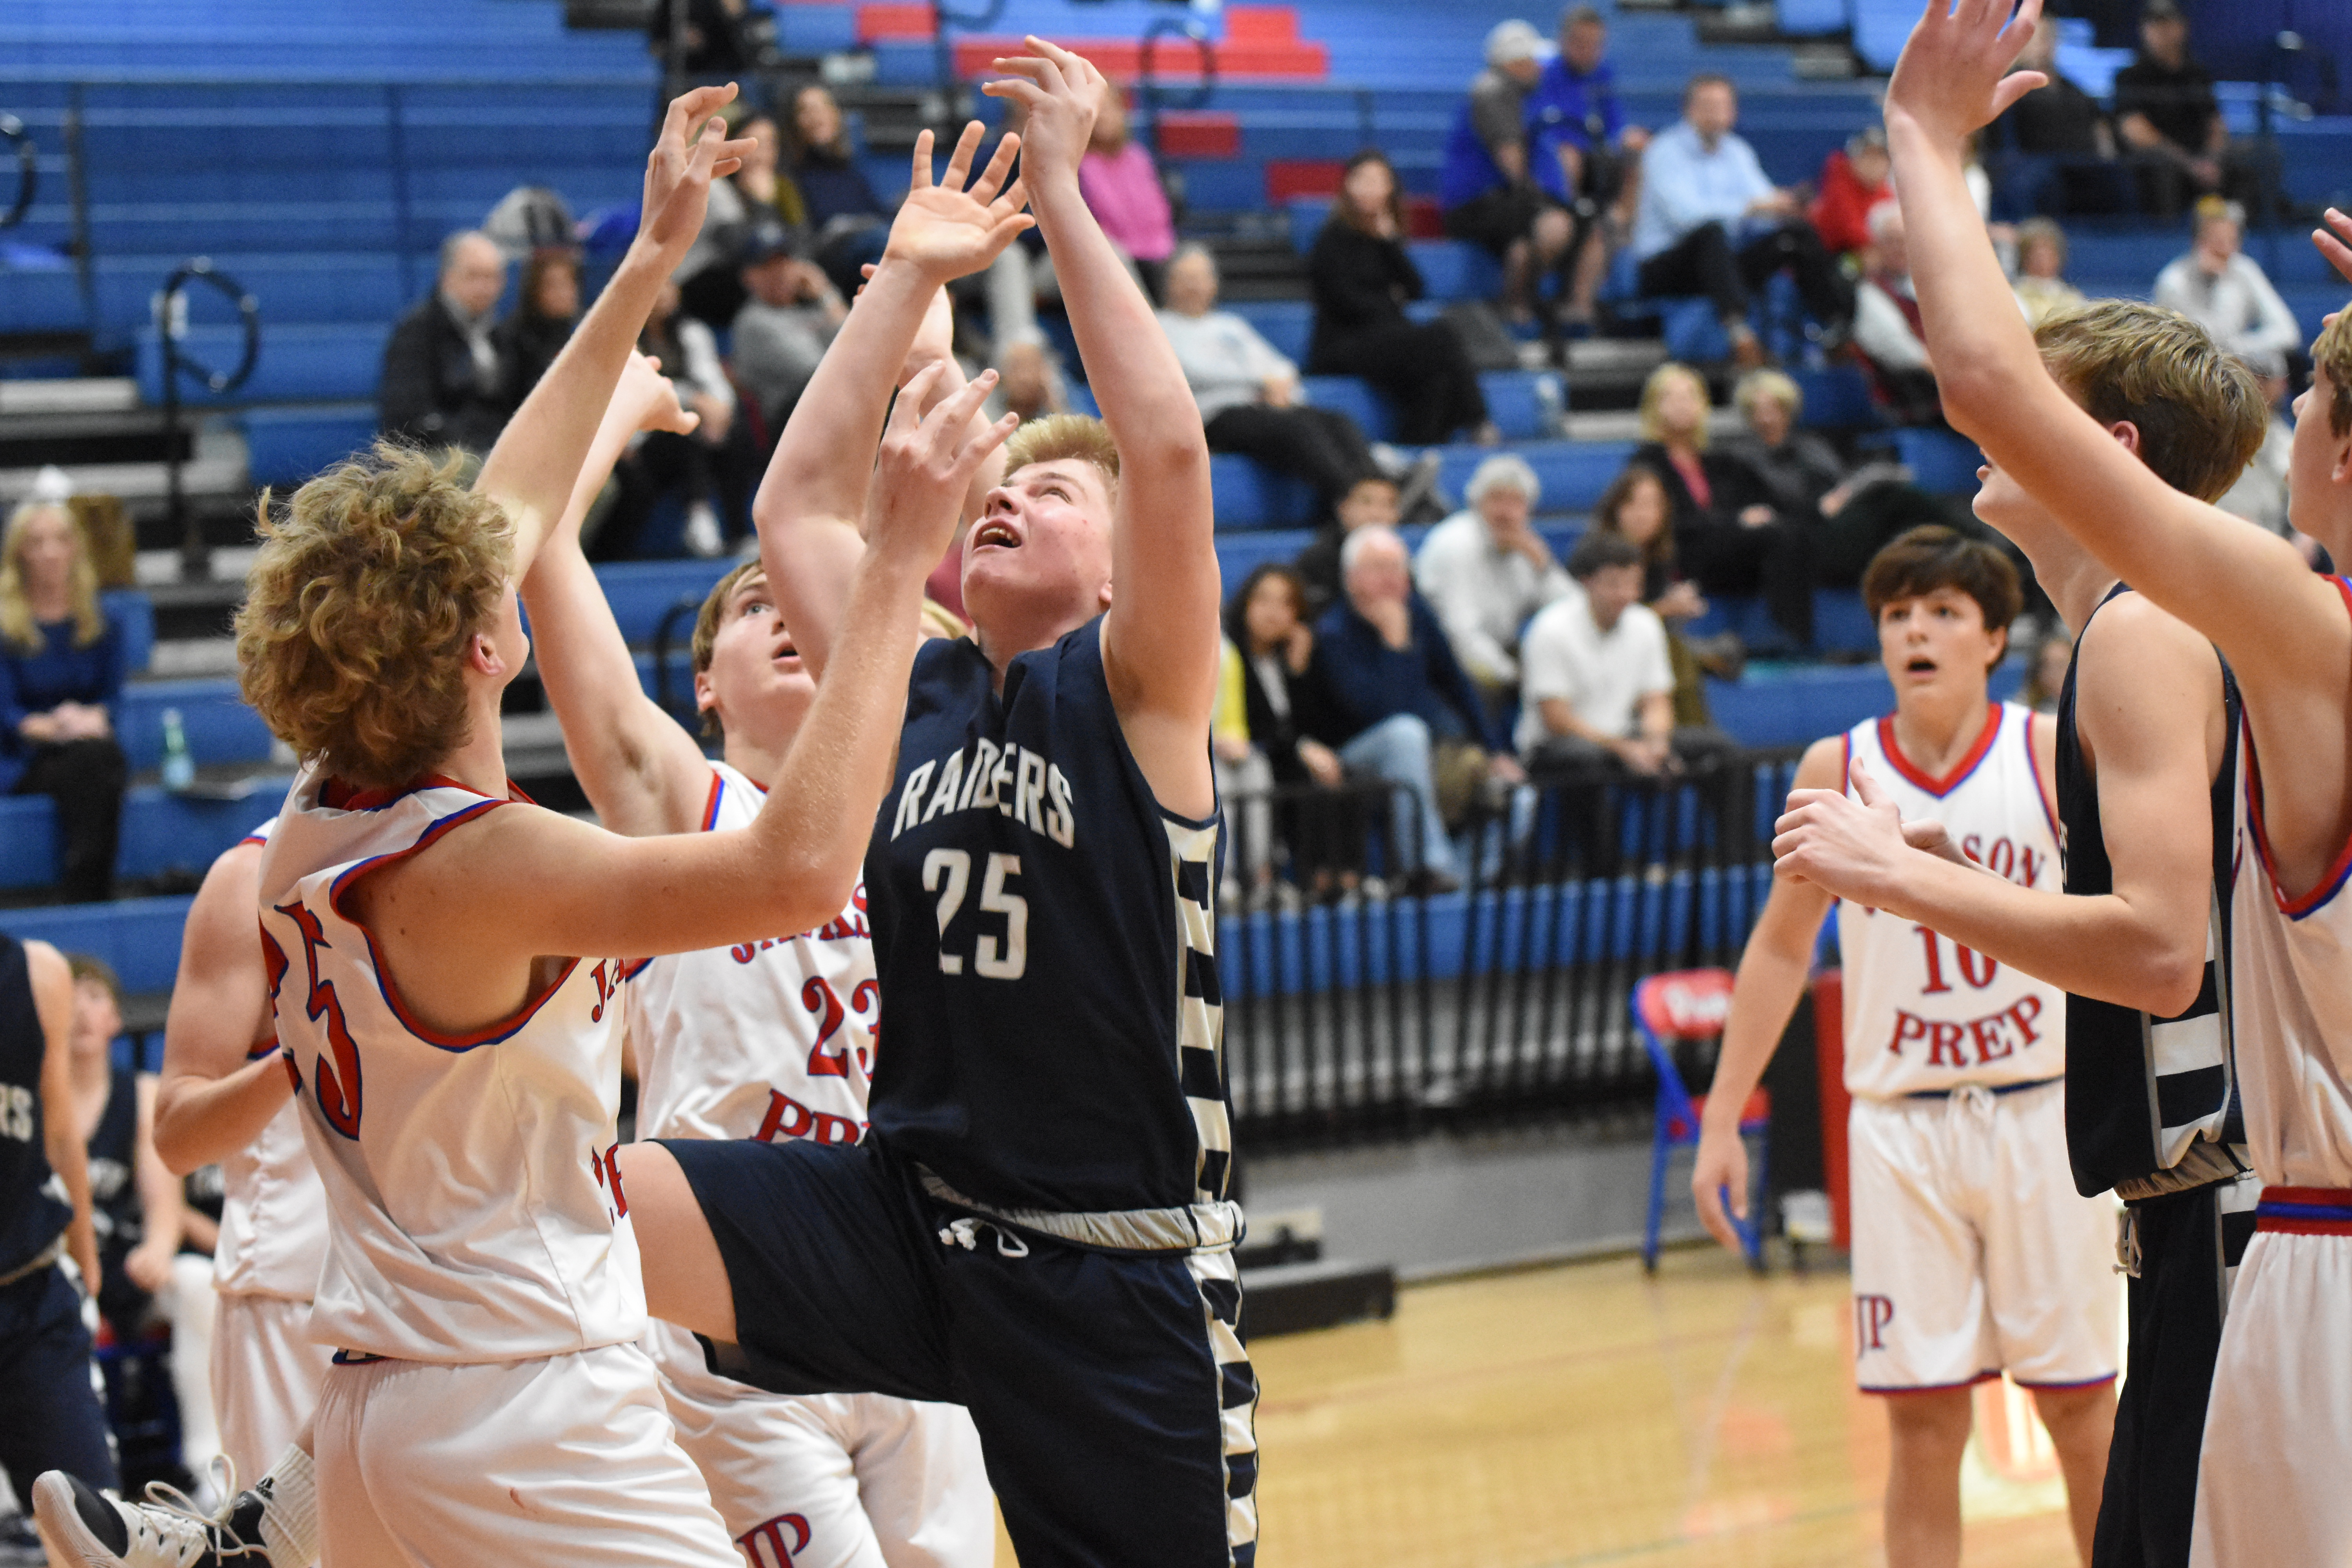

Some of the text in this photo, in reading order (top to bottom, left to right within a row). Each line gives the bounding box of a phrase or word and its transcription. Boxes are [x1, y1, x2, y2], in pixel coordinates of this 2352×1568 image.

[891, 737, 1074, 849] RAIDERS
[922, 848, 1028, 980] 25
[1913, 924, 1998, 995] 10
[1888, 994, 2042, 1069] PREP
